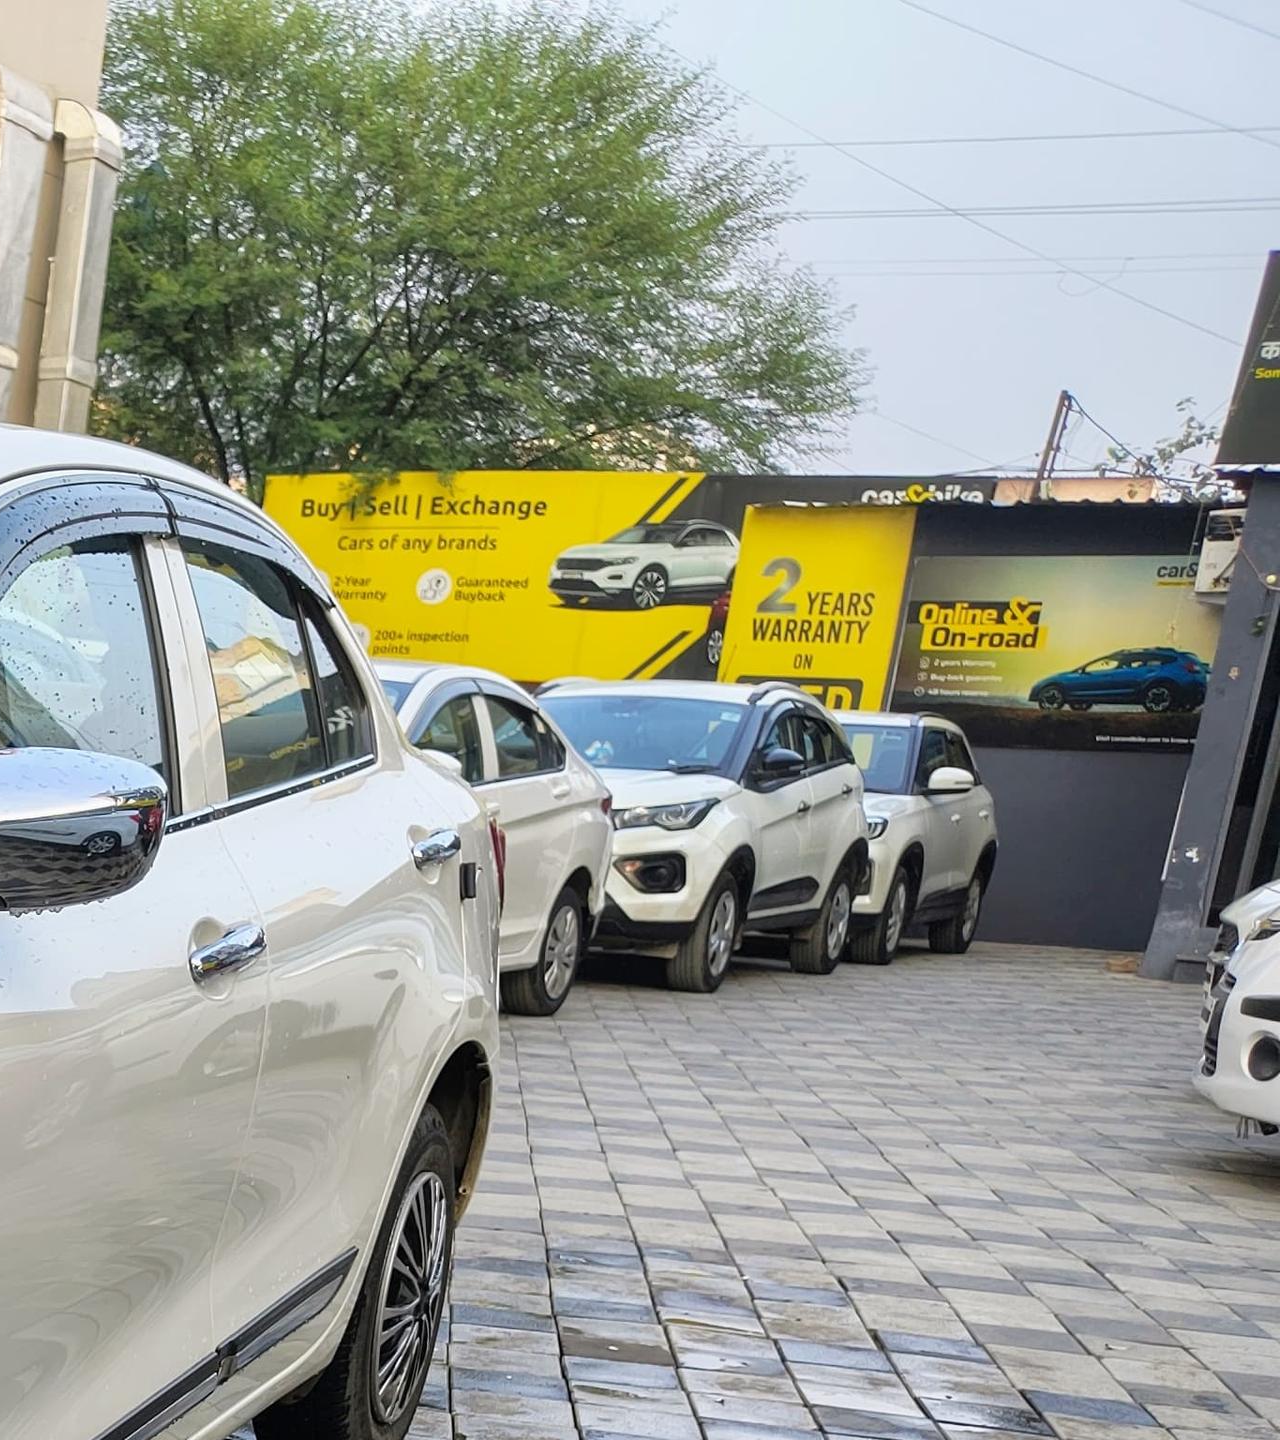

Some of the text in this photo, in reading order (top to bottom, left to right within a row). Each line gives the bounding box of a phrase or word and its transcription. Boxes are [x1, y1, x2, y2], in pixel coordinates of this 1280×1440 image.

[301, 499, 342, 521] Buy
[363, 495, 408, 516] Sell
[430, 495, 548, 520] Exchange
[337, 533, 497, 554] Cars of any brands
[333, 575, 372, 587] 2-Year
[455, 576, 529, 588] Guaranteed
[756, 557, 876, 616] 2 YEARS
[454, 589, 505, 602] Buyback
[919, 596, 1042, 625] Online &
[374, 630, 469, 643] 200+ inspection
[752, 618, 870, 644] WARRANTY
[930, 626, 1040, 648] On-road
[372, 643, 410, 656] points
[793, 654, 813, 669] ON
